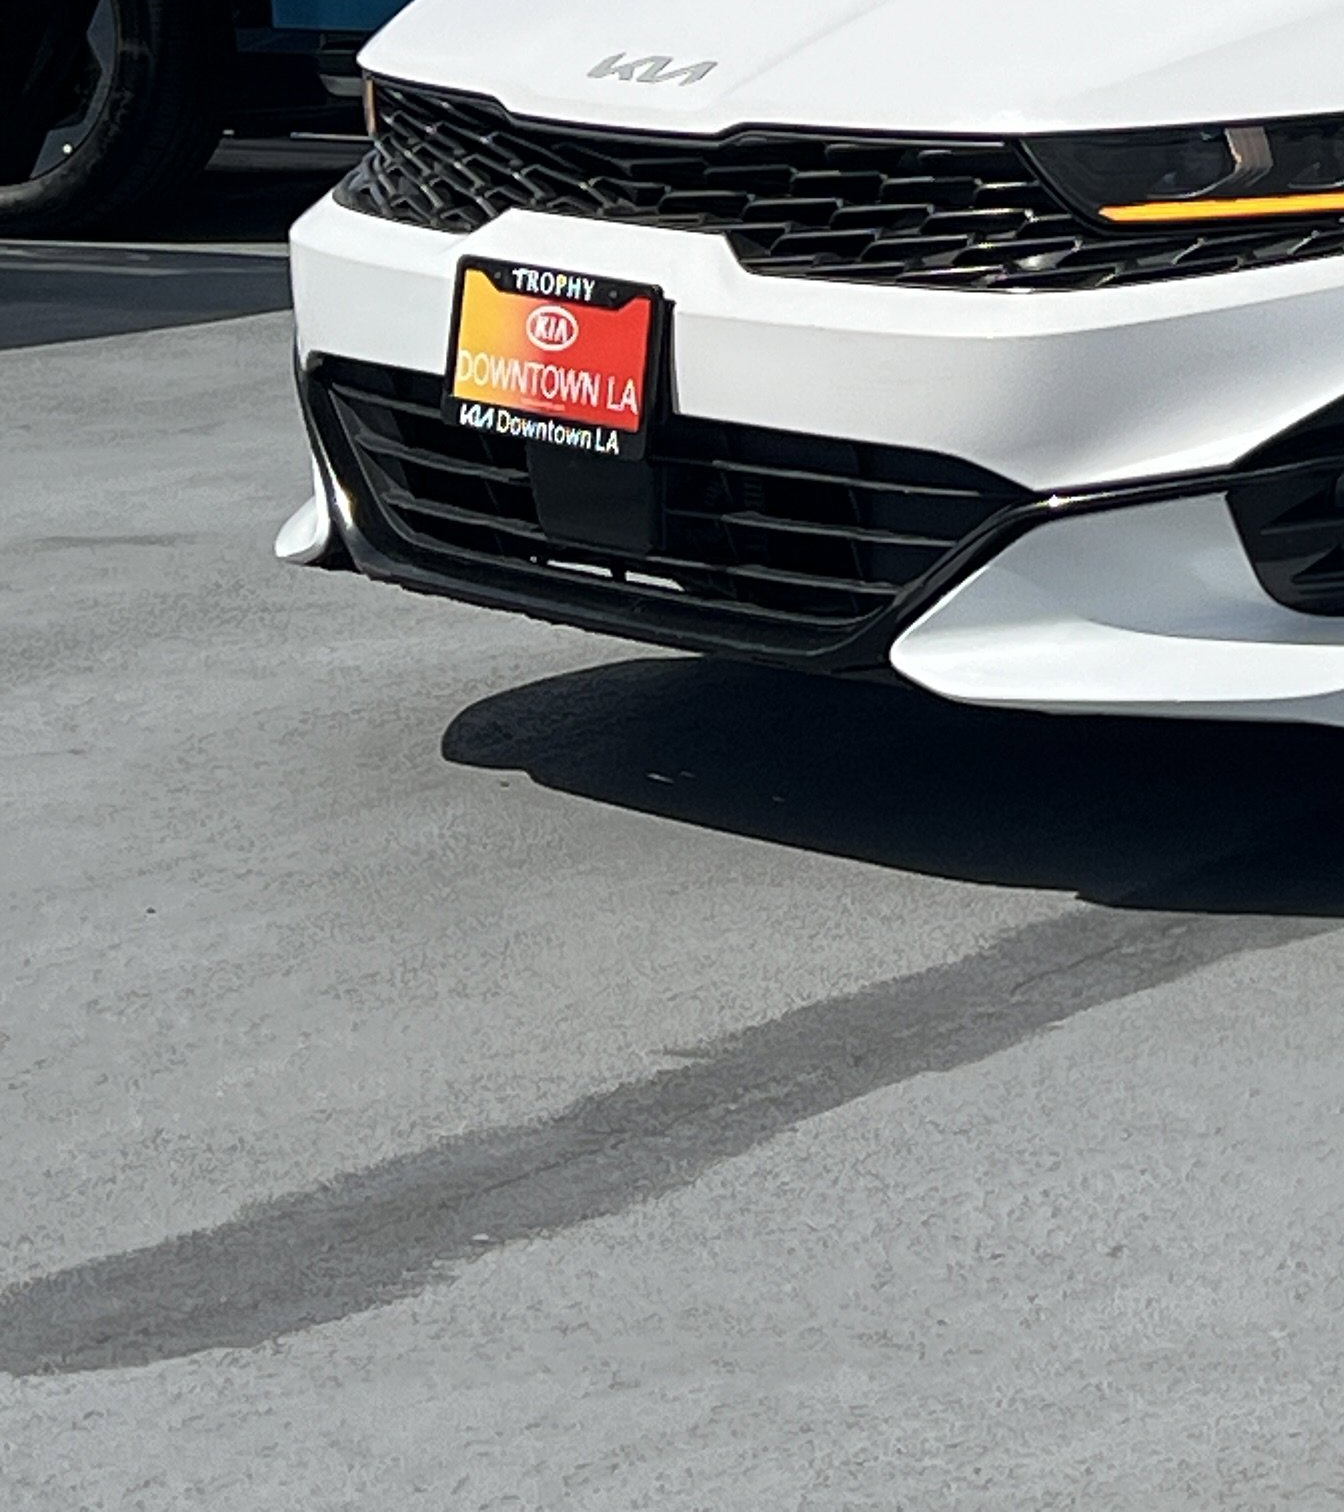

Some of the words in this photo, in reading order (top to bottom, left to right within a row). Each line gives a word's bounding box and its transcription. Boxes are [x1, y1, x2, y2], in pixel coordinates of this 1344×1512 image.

[586, 52, 719, 87] KIA
[512, 267, 595, 302] TROPHY
[534, 315, 568, 342] KIA
[457, 350, 600, 408] DOWNTOWN
[606, 375, 638, 415] LA
[459, 403, 494, 429] KIA
[496, 409, 592, 451] Downtown
[594, 429, 620, 455] LA
